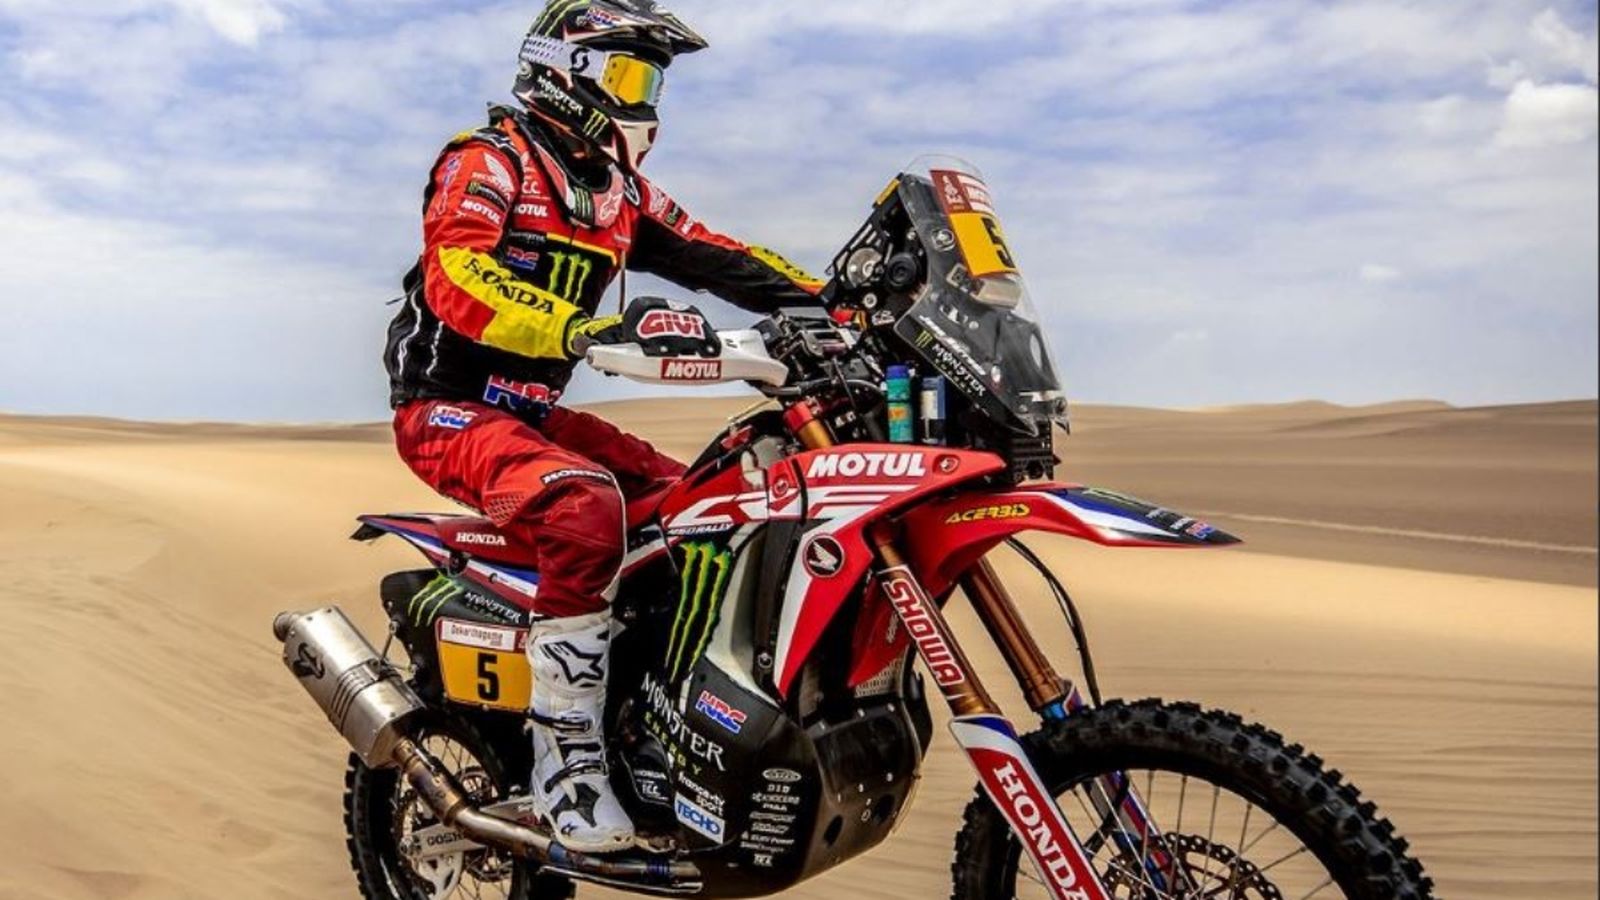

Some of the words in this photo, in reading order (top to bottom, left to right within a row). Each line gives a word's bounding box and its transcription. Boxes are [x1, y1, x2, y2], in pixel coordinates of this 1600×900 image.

[461, 199, 501, 225] MOTUL
[980, 217, 1017, 269] 5
[463, 257, 556, 315] HONDA
[638, 311, 706, 338] GIVI
[663, 361, 721, 378] MOTUL
[932, 343, 987, 398] MONSTER
[807, 452, 927, 479] MOTUL
[944, 503, 1031, 525] ACERBIS
[455, 532, 507, 546] HONDA
[464, 591, 522, 623] MONSTER
[882, 577, 965, 686] SHOWA
[477, 652, 499, 701] 5
[641, 672, 726, 772] MONSTER
[695, 689, 748, 735] HRC
[644, 711, 703, 775] ENERGY
